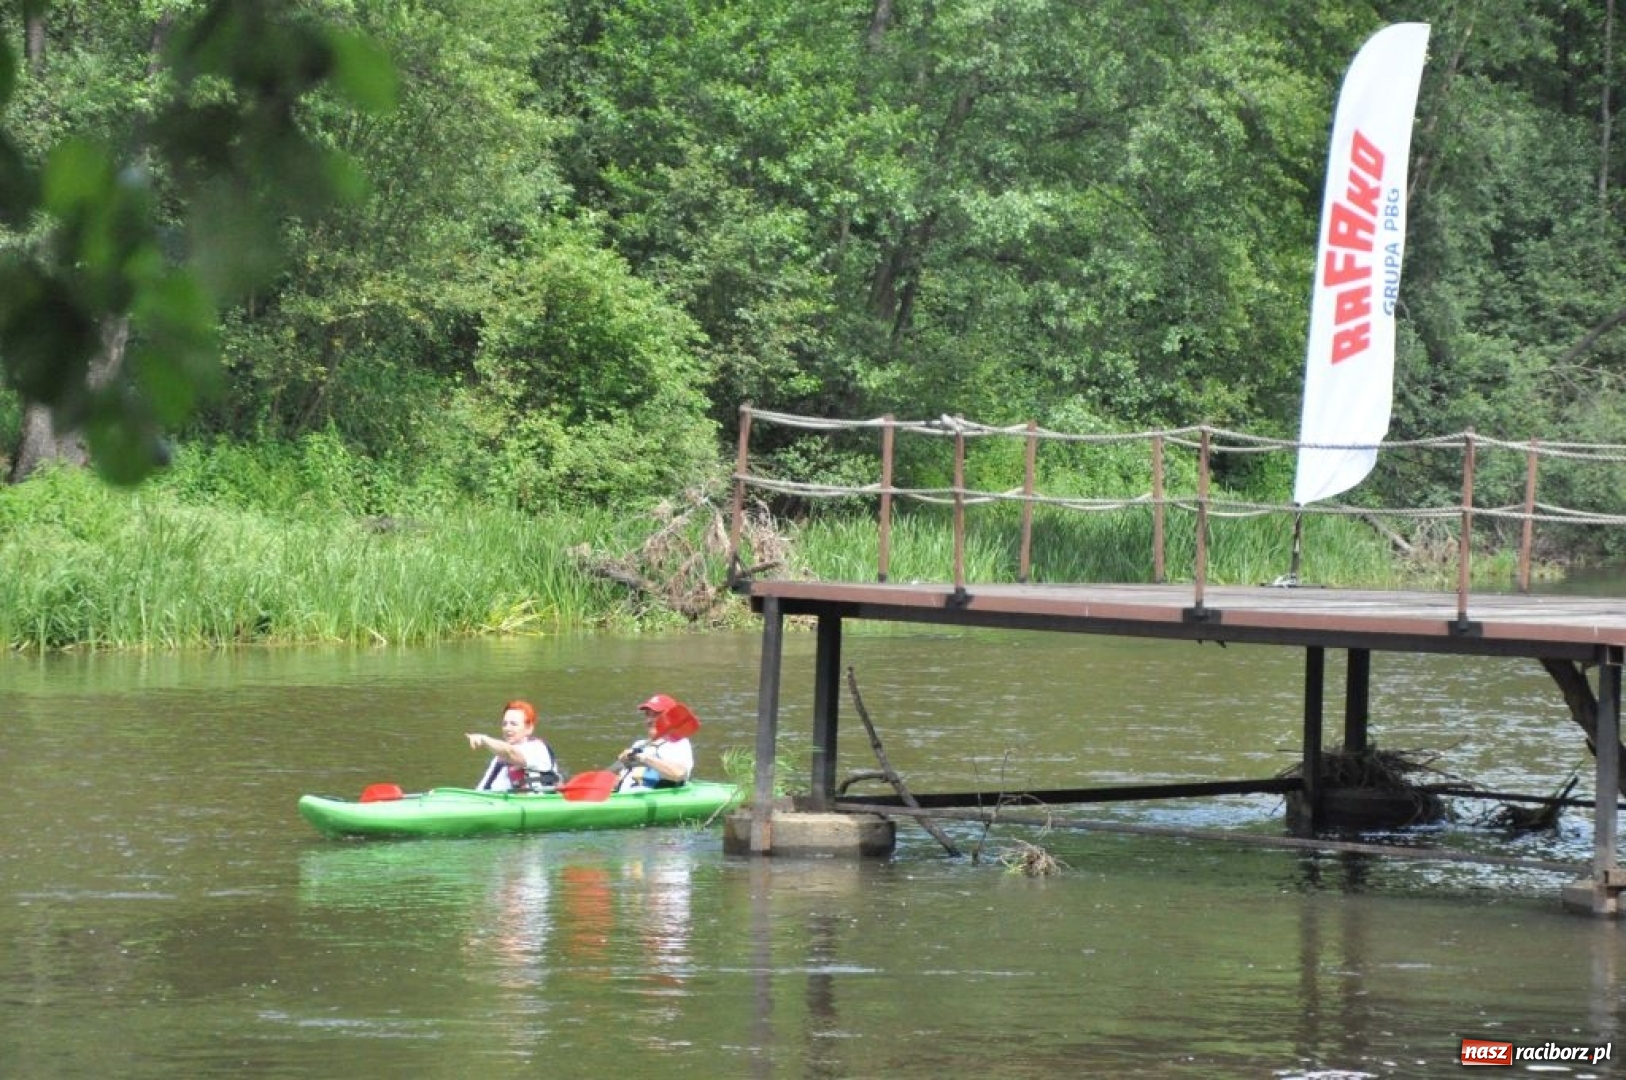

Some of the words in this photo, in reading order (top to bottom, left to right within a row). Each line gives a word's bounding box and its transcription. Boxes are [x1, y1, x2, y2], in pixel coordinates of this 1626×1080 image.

[1384, 188, 1399, 231] PBG
[1323, 129, 1384, 365] RAFAKO
[1383, 242, 1400, 316] GRUPA
